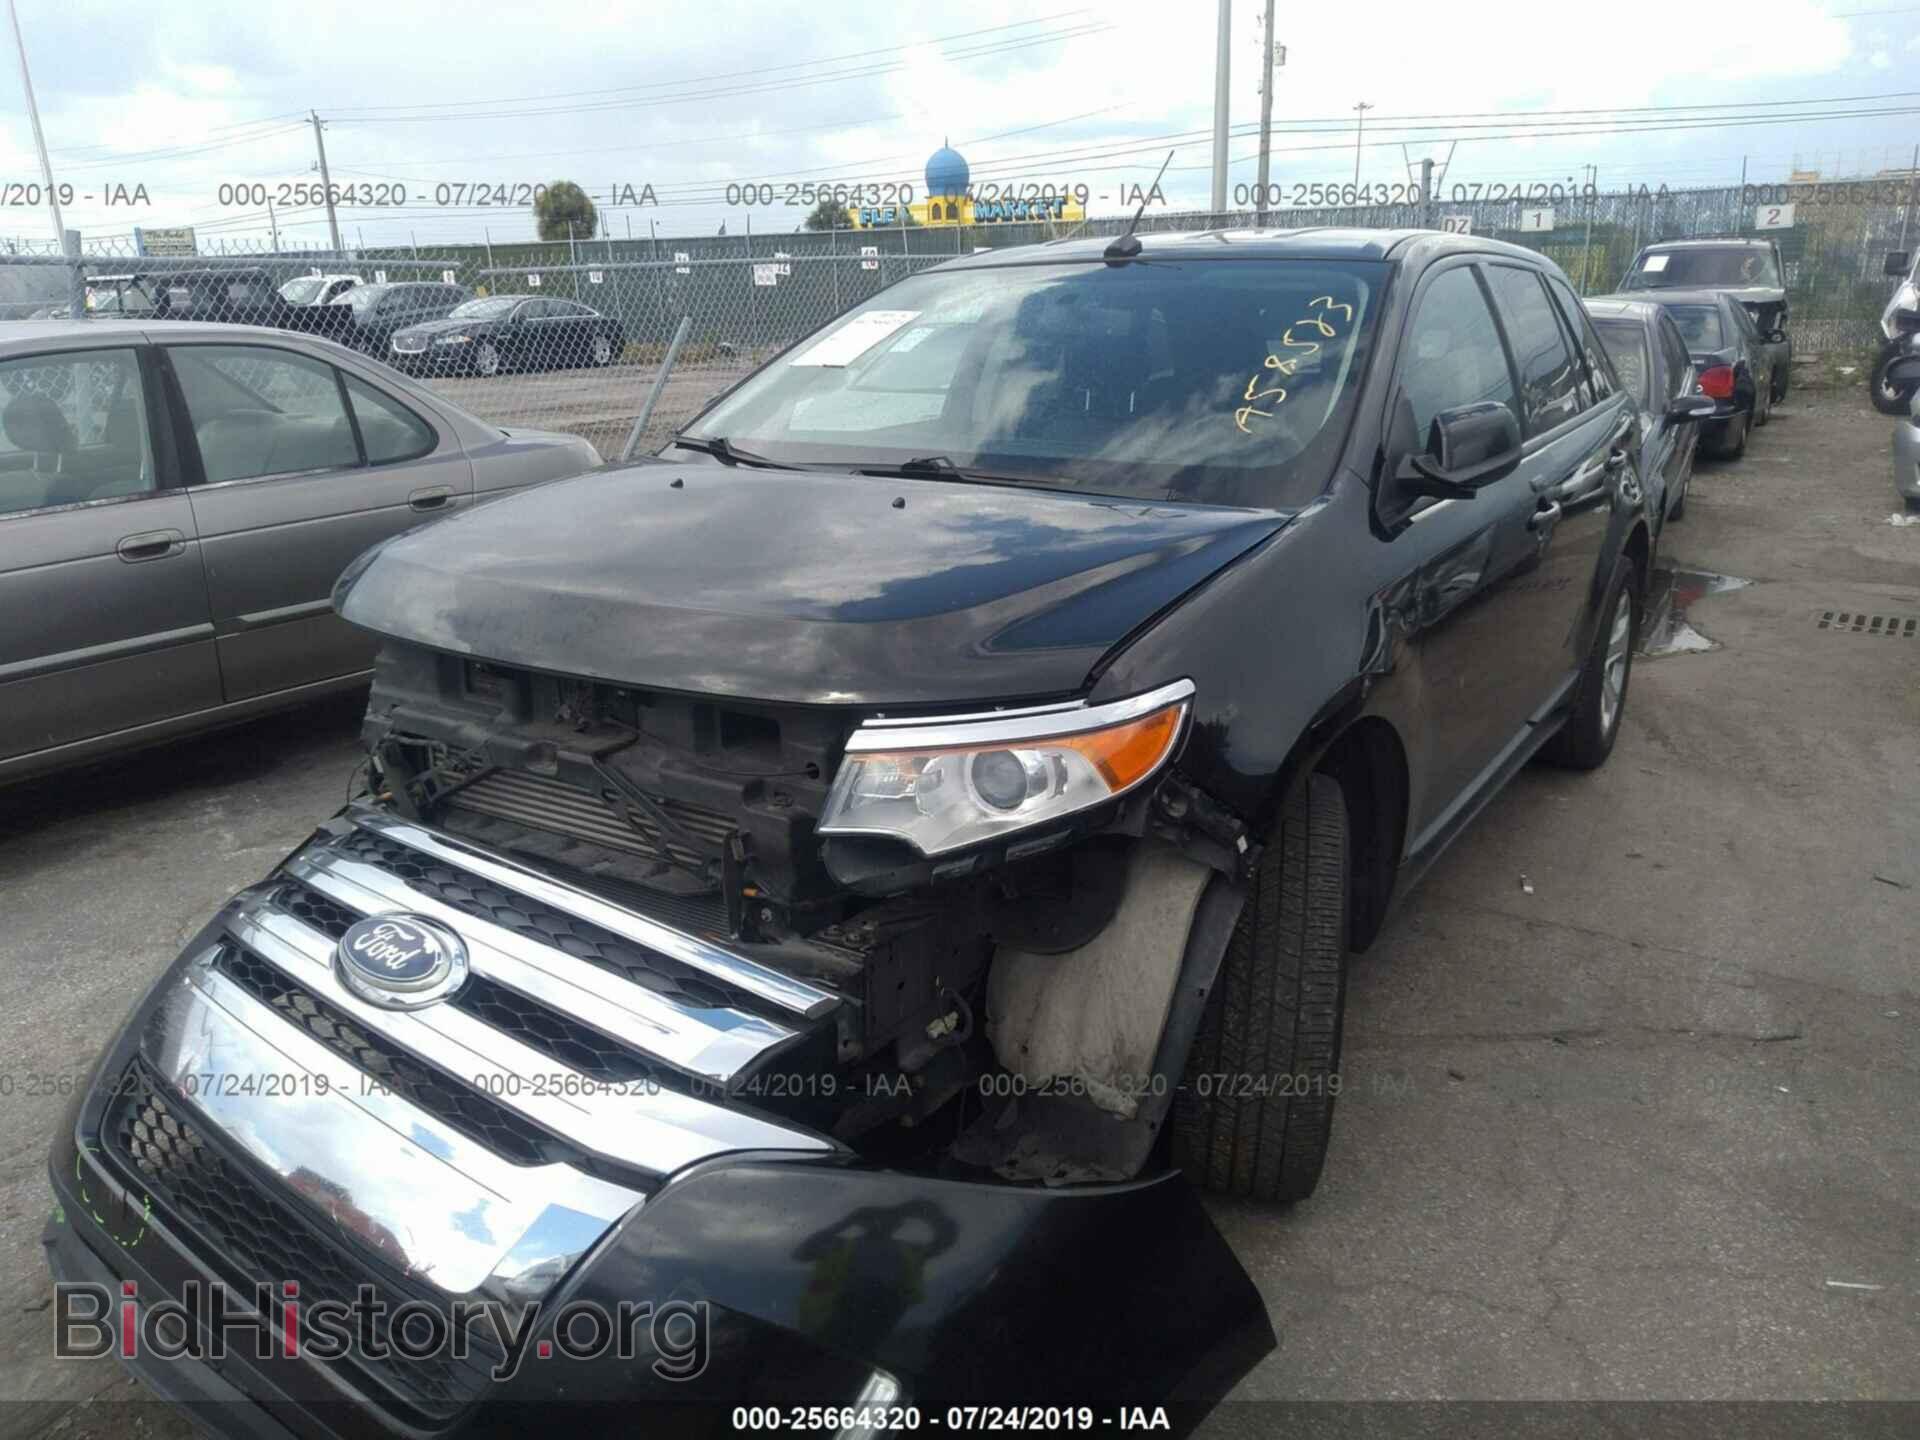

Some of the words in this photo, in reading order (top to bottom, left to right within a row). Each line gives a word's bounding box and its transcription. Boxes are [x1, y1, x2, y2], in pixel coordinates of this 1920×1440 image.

[859, 207, 911, 228] FLEA
[973, 197, 1066, 223] MARKET
[1533, 211, 1543, 228] 1
[1766, 207, 1781, 225] 2
[353, 922, 422, 970] Ford
